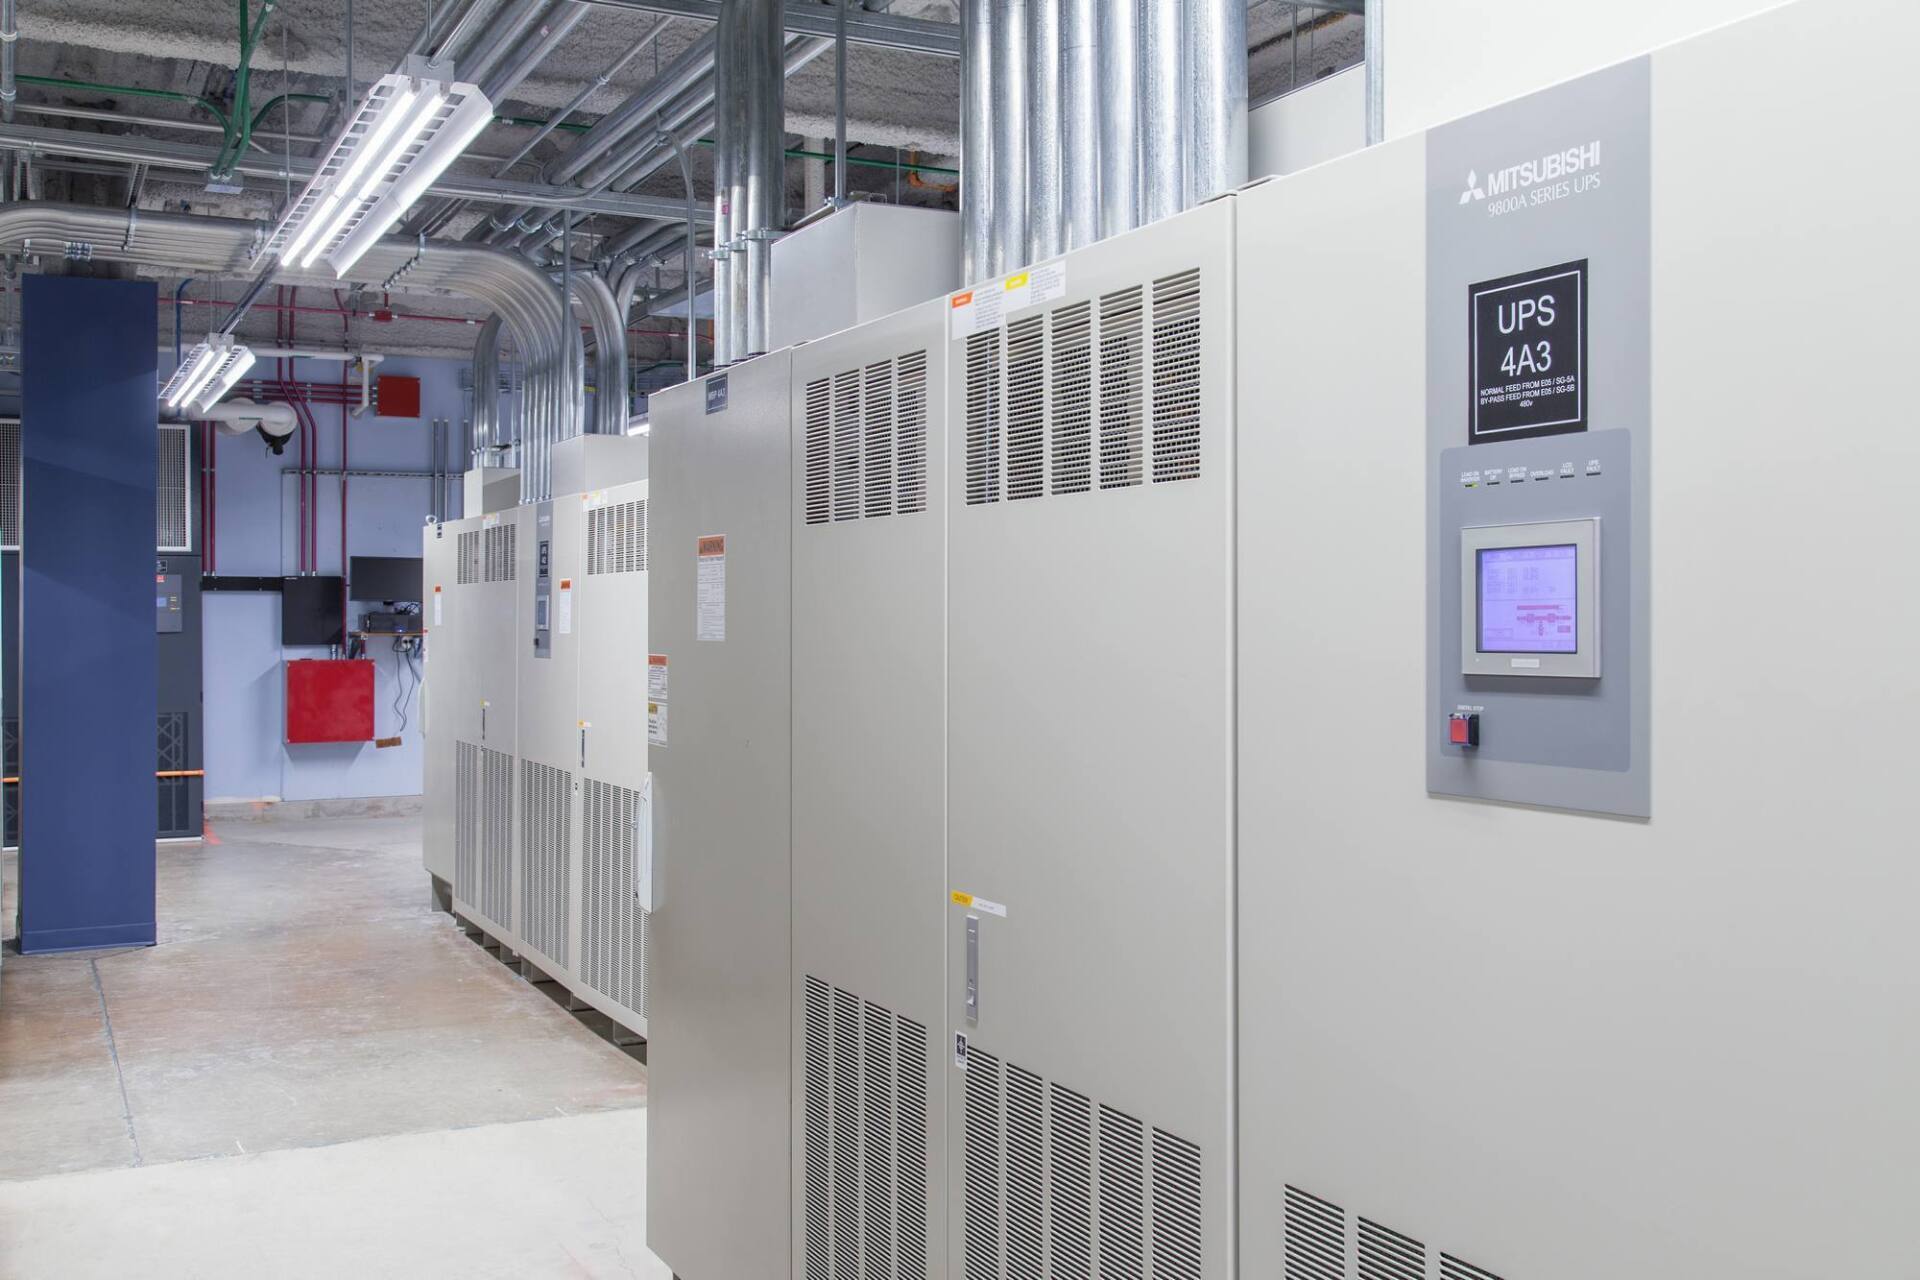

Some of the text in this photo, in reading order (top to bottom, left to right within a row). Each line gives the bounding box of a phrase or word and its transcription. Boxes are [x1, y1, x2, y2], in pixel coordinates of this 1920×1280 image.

[1487, 140, 1601, 197] MITSUBISHI
[1488, 171, 1601, 218] 9800A SERIES UPS
[1498, 294, 1556, 335] UPS
[1500, 340, 1552, 377] 4A3
[1480, 386, 1504, 396] NORMAL
[1505, 383, 1521, 392] FEED
[1522, 380, 1540, 390] FROM
[1480, 394, 1504, 405] BY-PASS
[1505, 392, 1521, 401] FEED
[1522, 389, 1540, 398] FROM
